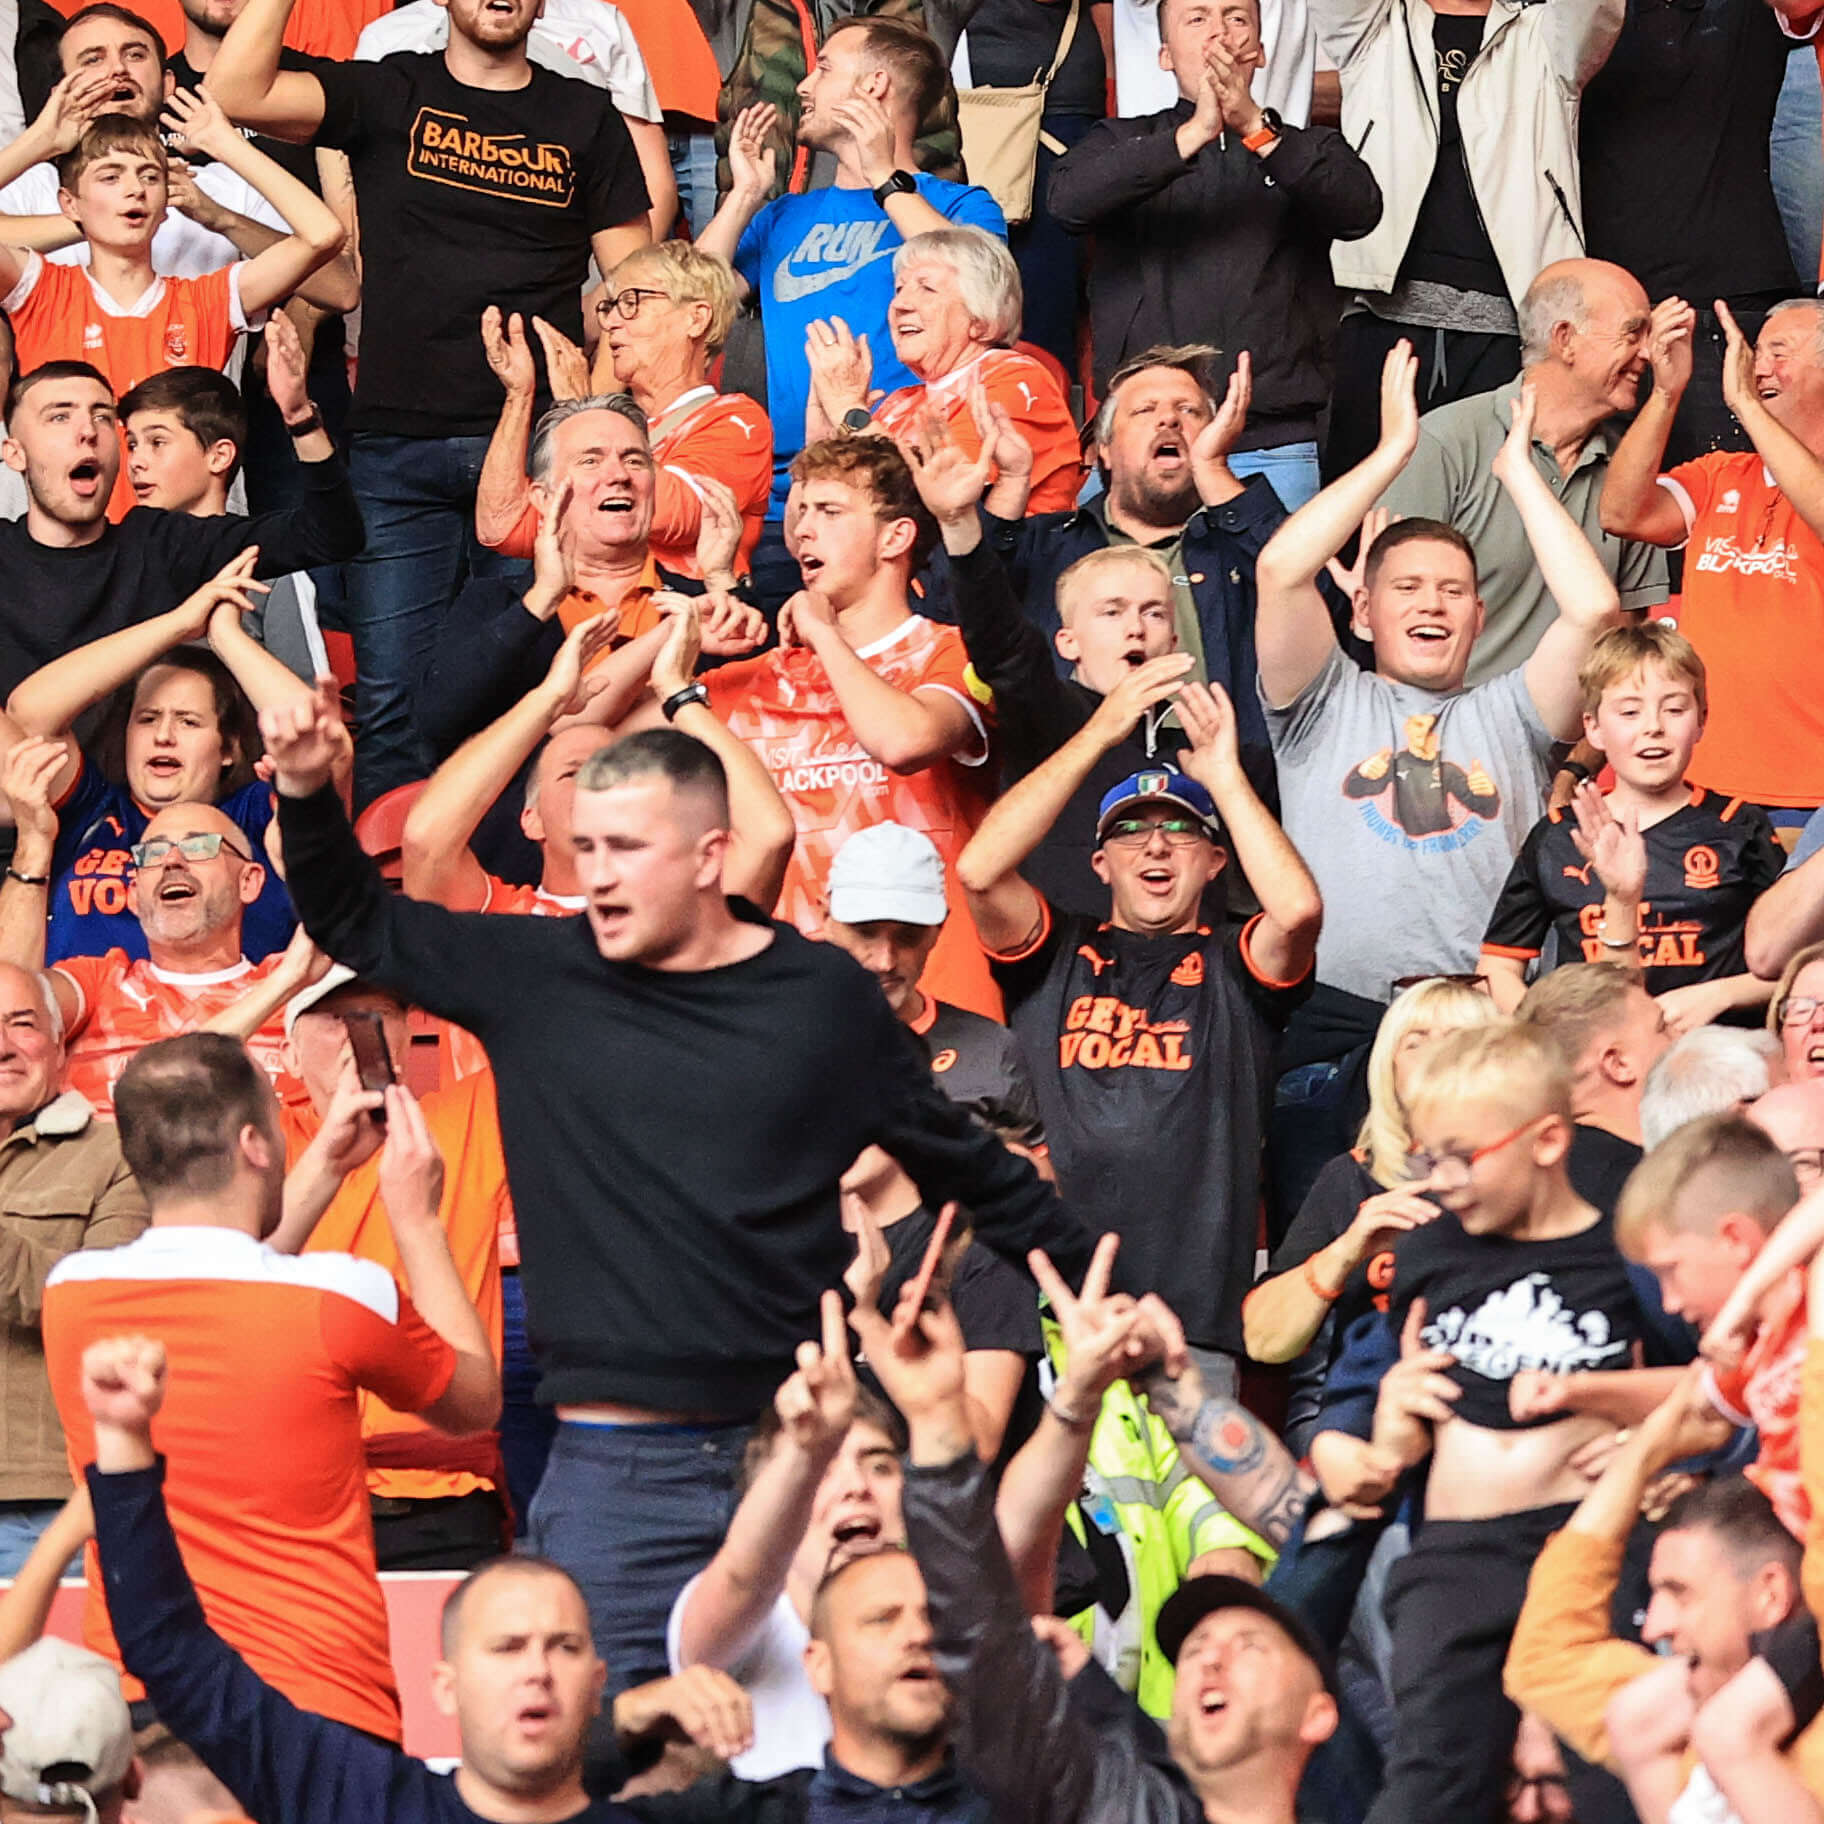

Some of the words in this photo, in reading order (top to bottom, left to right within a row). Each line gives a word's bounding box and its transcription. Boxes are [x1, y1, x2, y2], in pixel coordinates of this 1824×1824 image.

[419, 147, 566, 192] INTERNATIONAL
[796, 220, 889, 264] RUN
[777, 762, 889, 794] LACKPOOL
[1065, 996, 1142, 1037] GET
[1060, 1033, 1192, 1071] VOCAL
